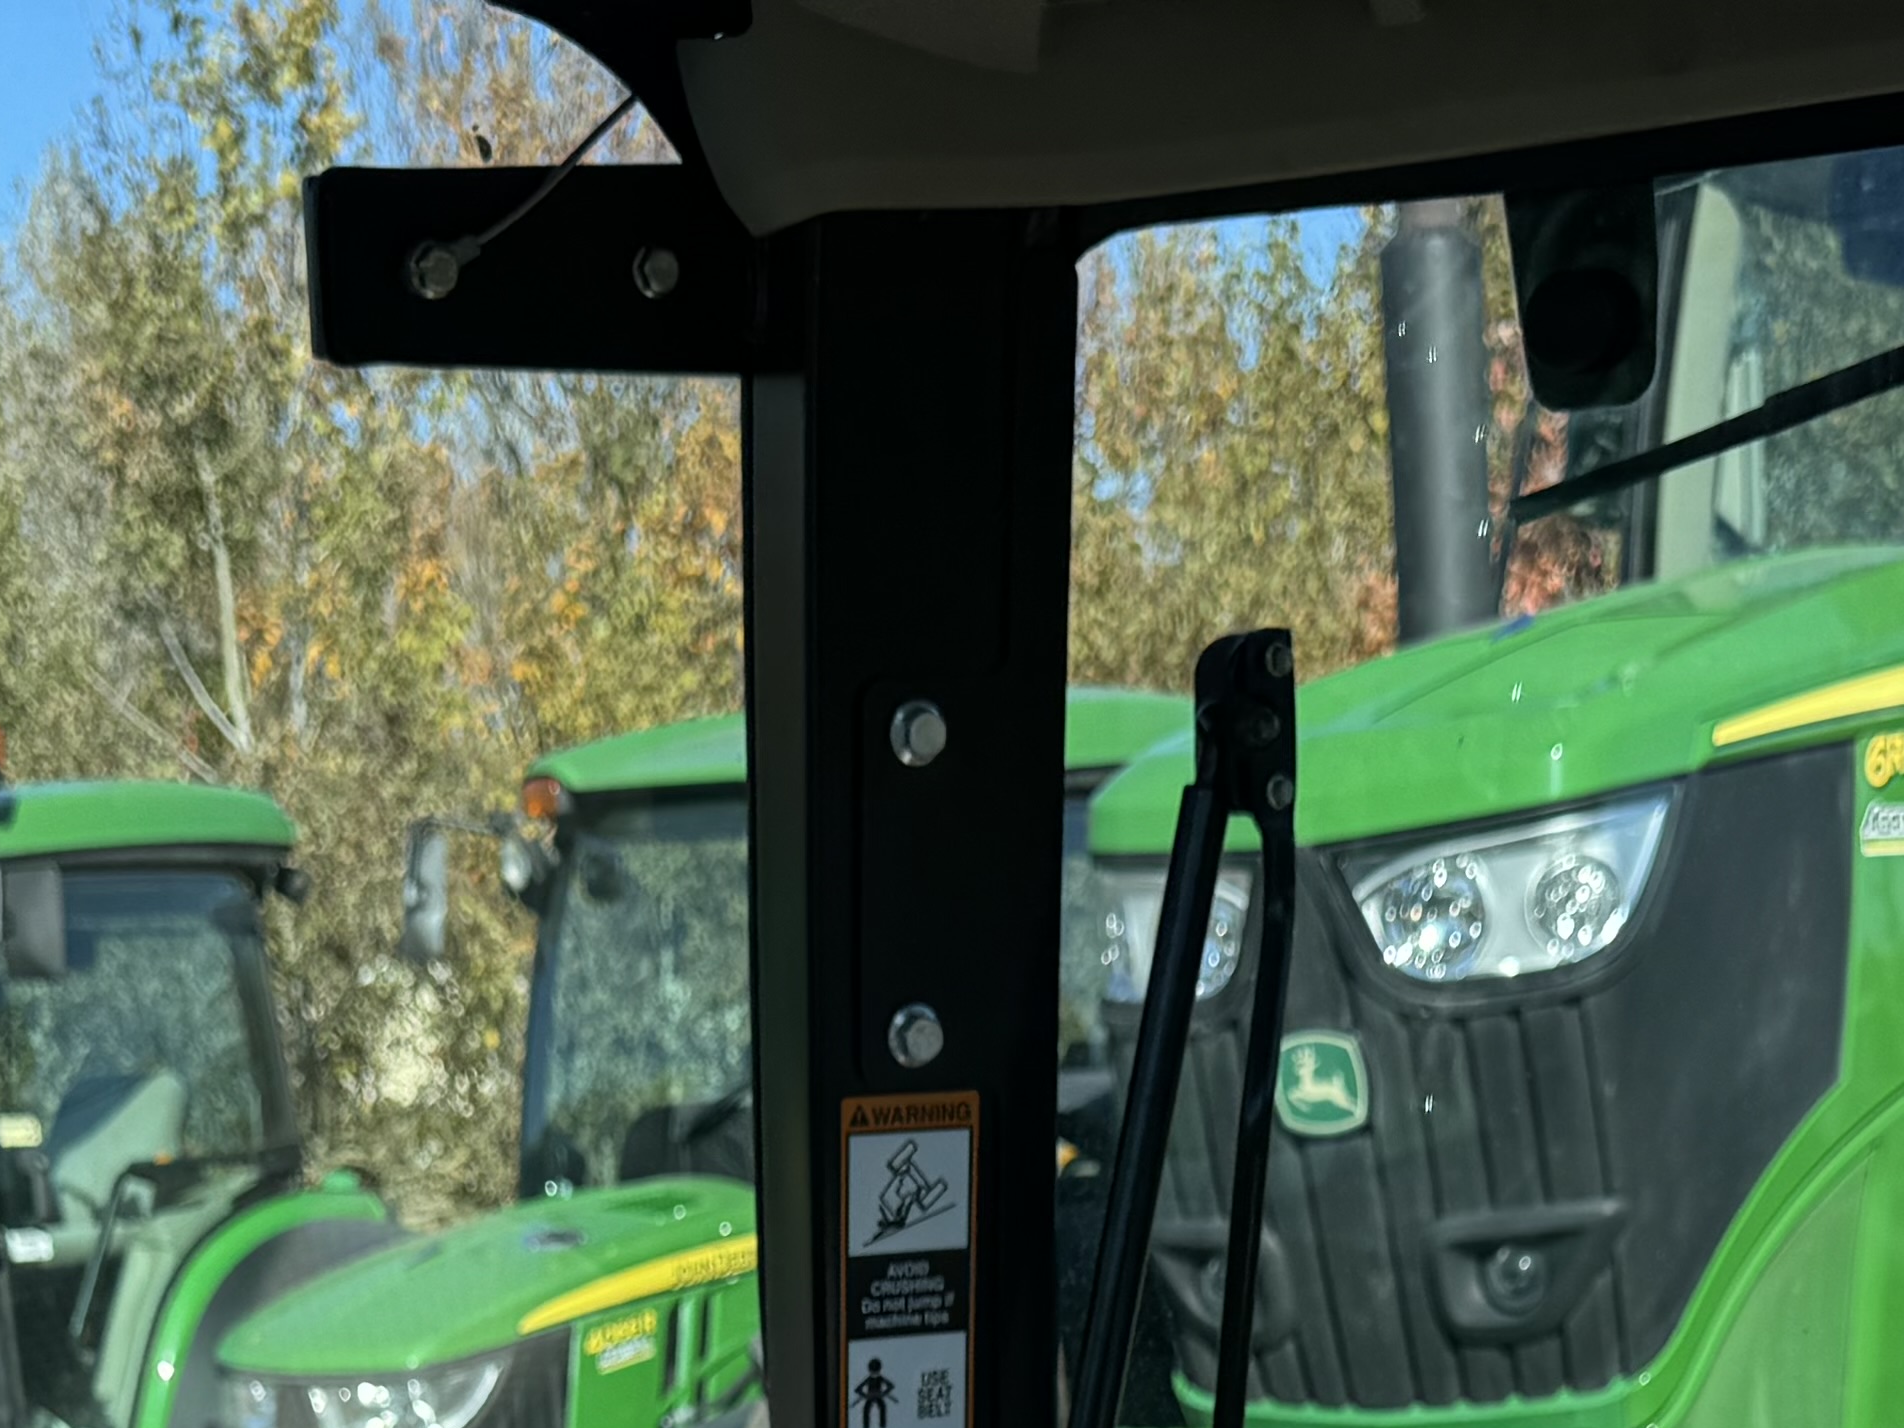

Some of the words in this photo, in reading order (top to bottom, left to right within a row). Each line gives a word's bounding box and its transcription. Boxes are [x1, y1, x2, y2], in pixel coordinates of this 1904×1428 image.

[871, 1102, 972, 1126] WARNING
[887, 1259, 930, 1279] AVOID
[870, 1275, 944, 1297] CRUSHING
[861, 1297, 881, 1314] Do
[883, 1296, 905, 1312] not
[907, 1294, 943, 1313] jump
[865, 1313, 922, 1331] machine
[924, 1310, 949, 1327] tips
[921, 1370, 949, 1386] USE
[918, 1385, 952, 1403] SEAT
[917, 1402, 952, 1420] BELT
